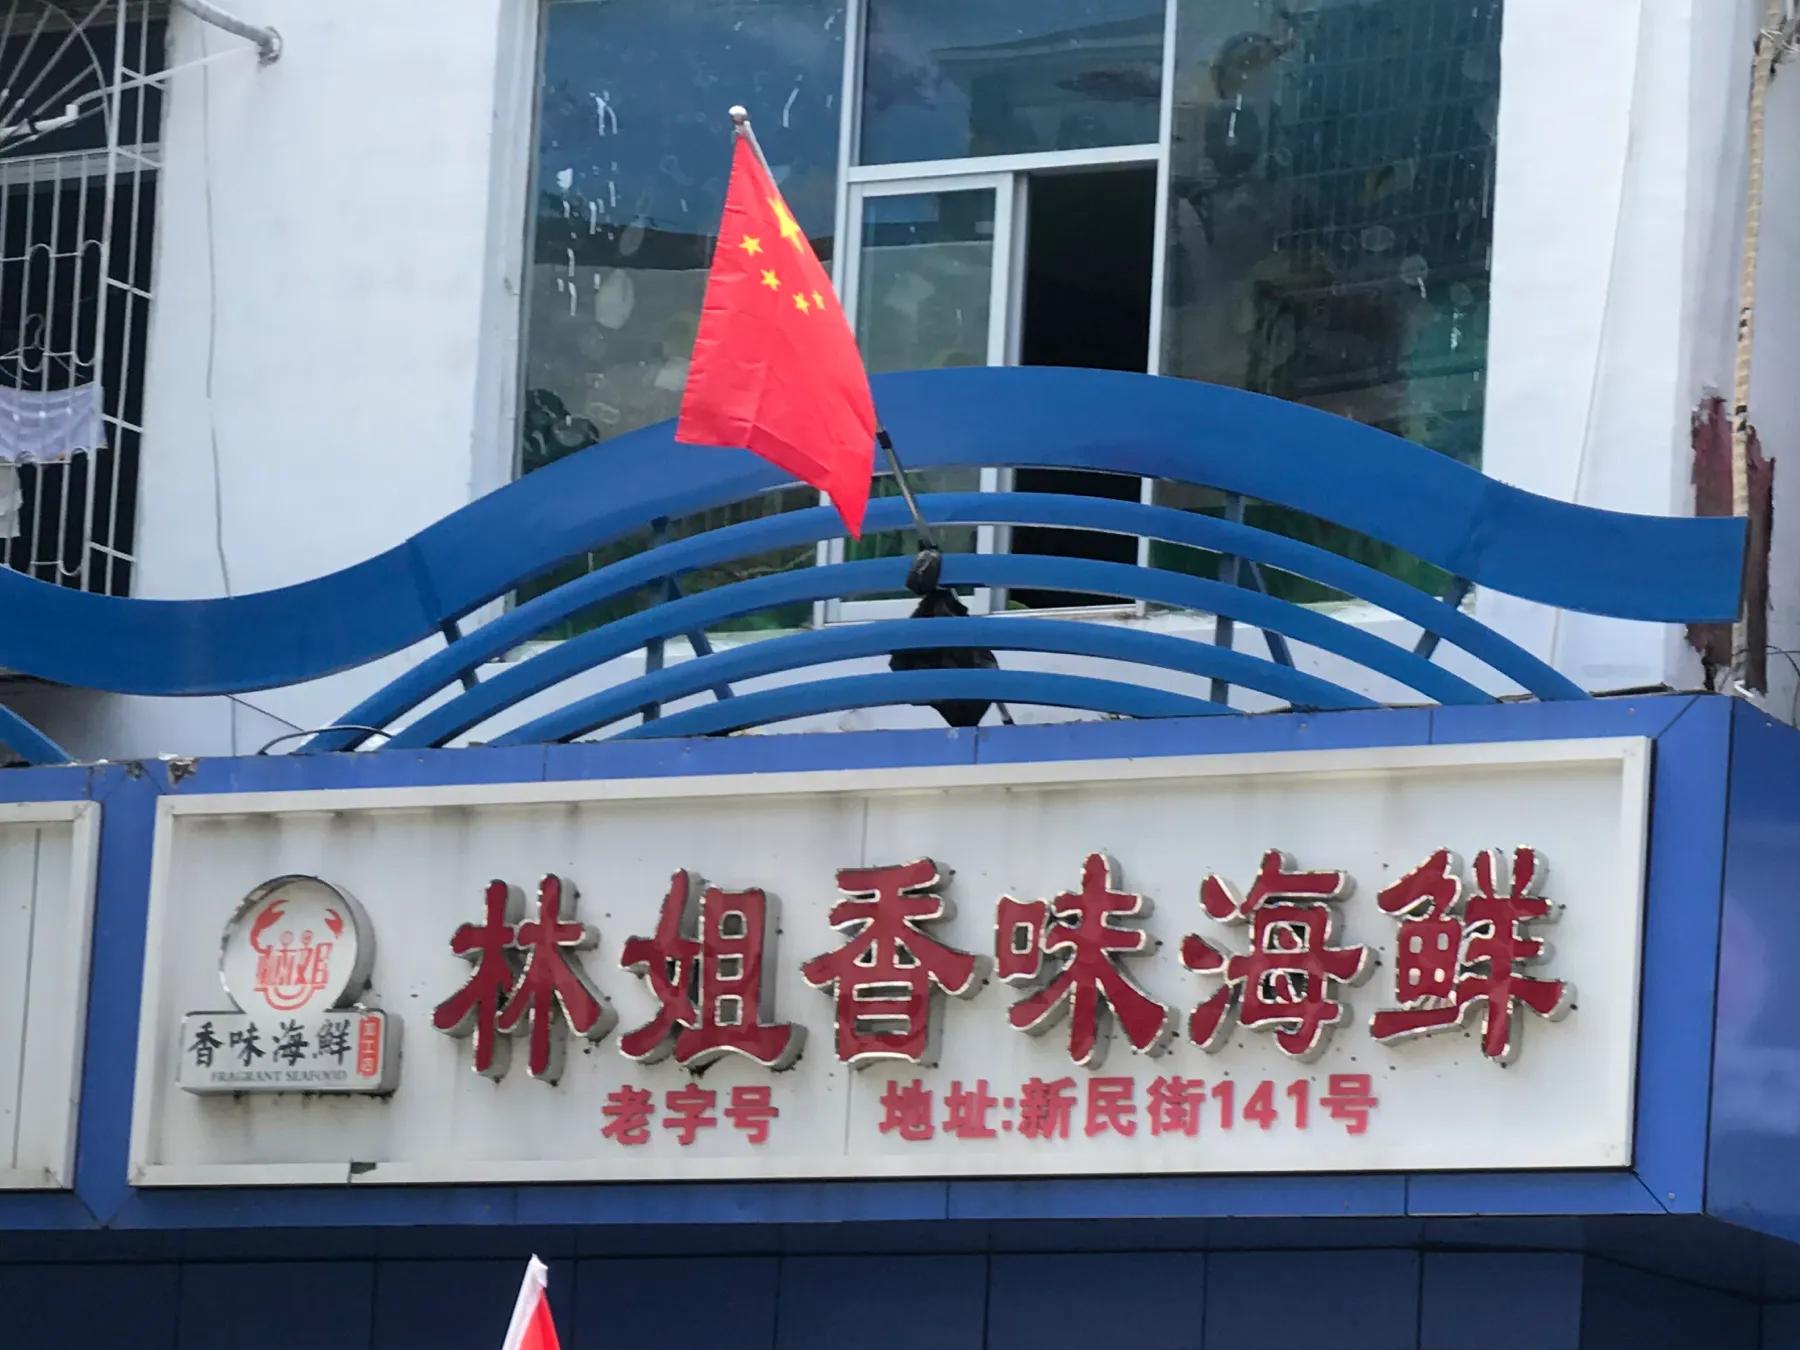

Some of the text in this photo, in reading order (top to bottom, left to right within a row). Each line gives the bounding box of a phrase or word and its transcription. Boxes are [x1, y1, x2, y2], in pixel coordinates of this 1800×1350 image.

[211, 1069, 347, 1083] FRAGRANT SEAFOOD
[602, 1083, 780, 1146] 老字号
